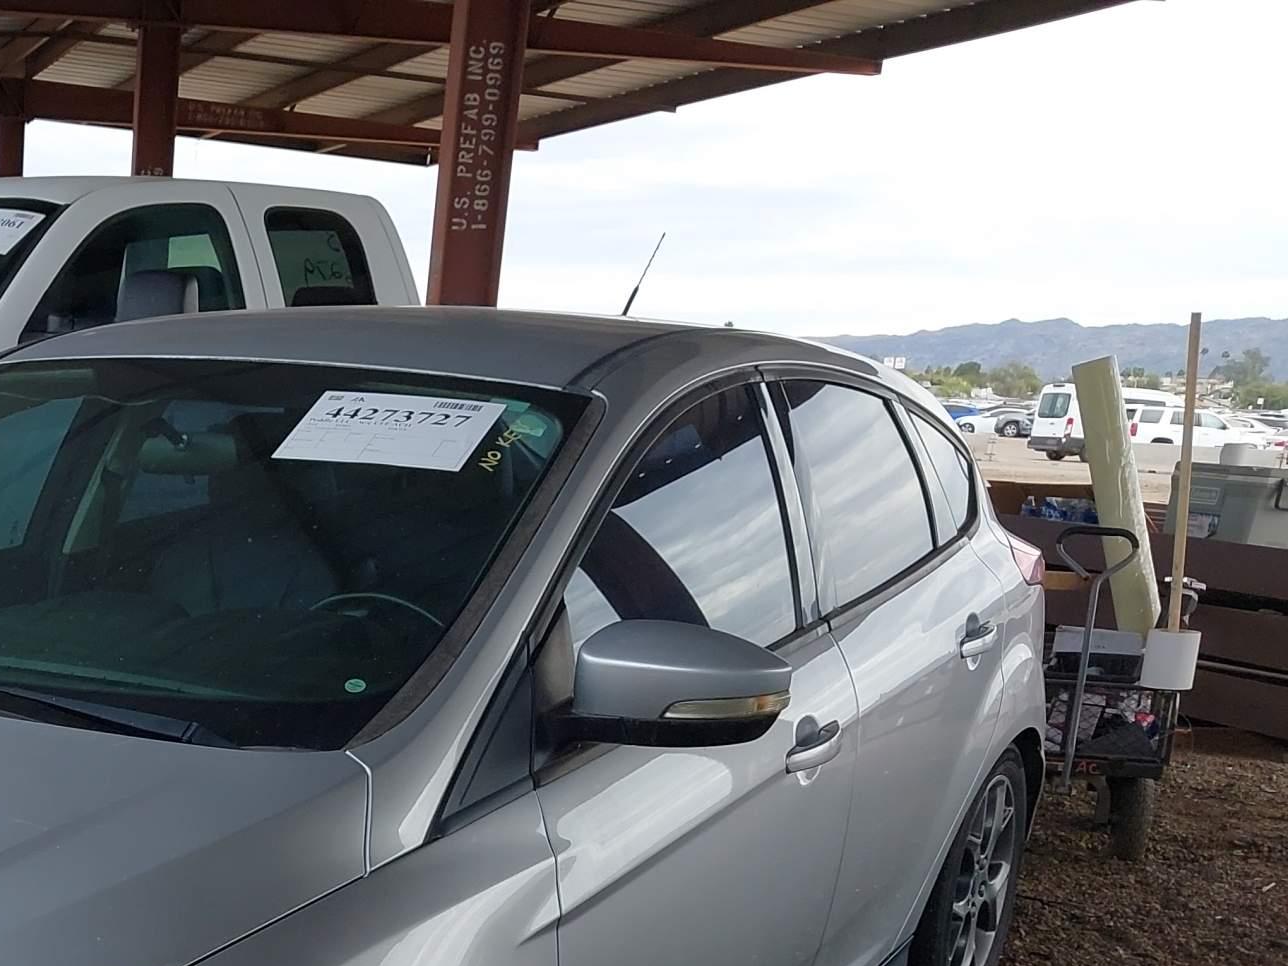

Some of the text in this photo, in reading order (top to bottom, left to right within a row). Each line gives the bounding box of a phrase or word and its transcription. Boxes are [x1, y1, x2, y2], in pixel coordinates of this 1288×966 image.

[451, 39, 487, 231] U.S. PREFAB INC.
[471, 41, 505, 230] 1-866-799-0969
[324, 405, 473, 428] 44273727
